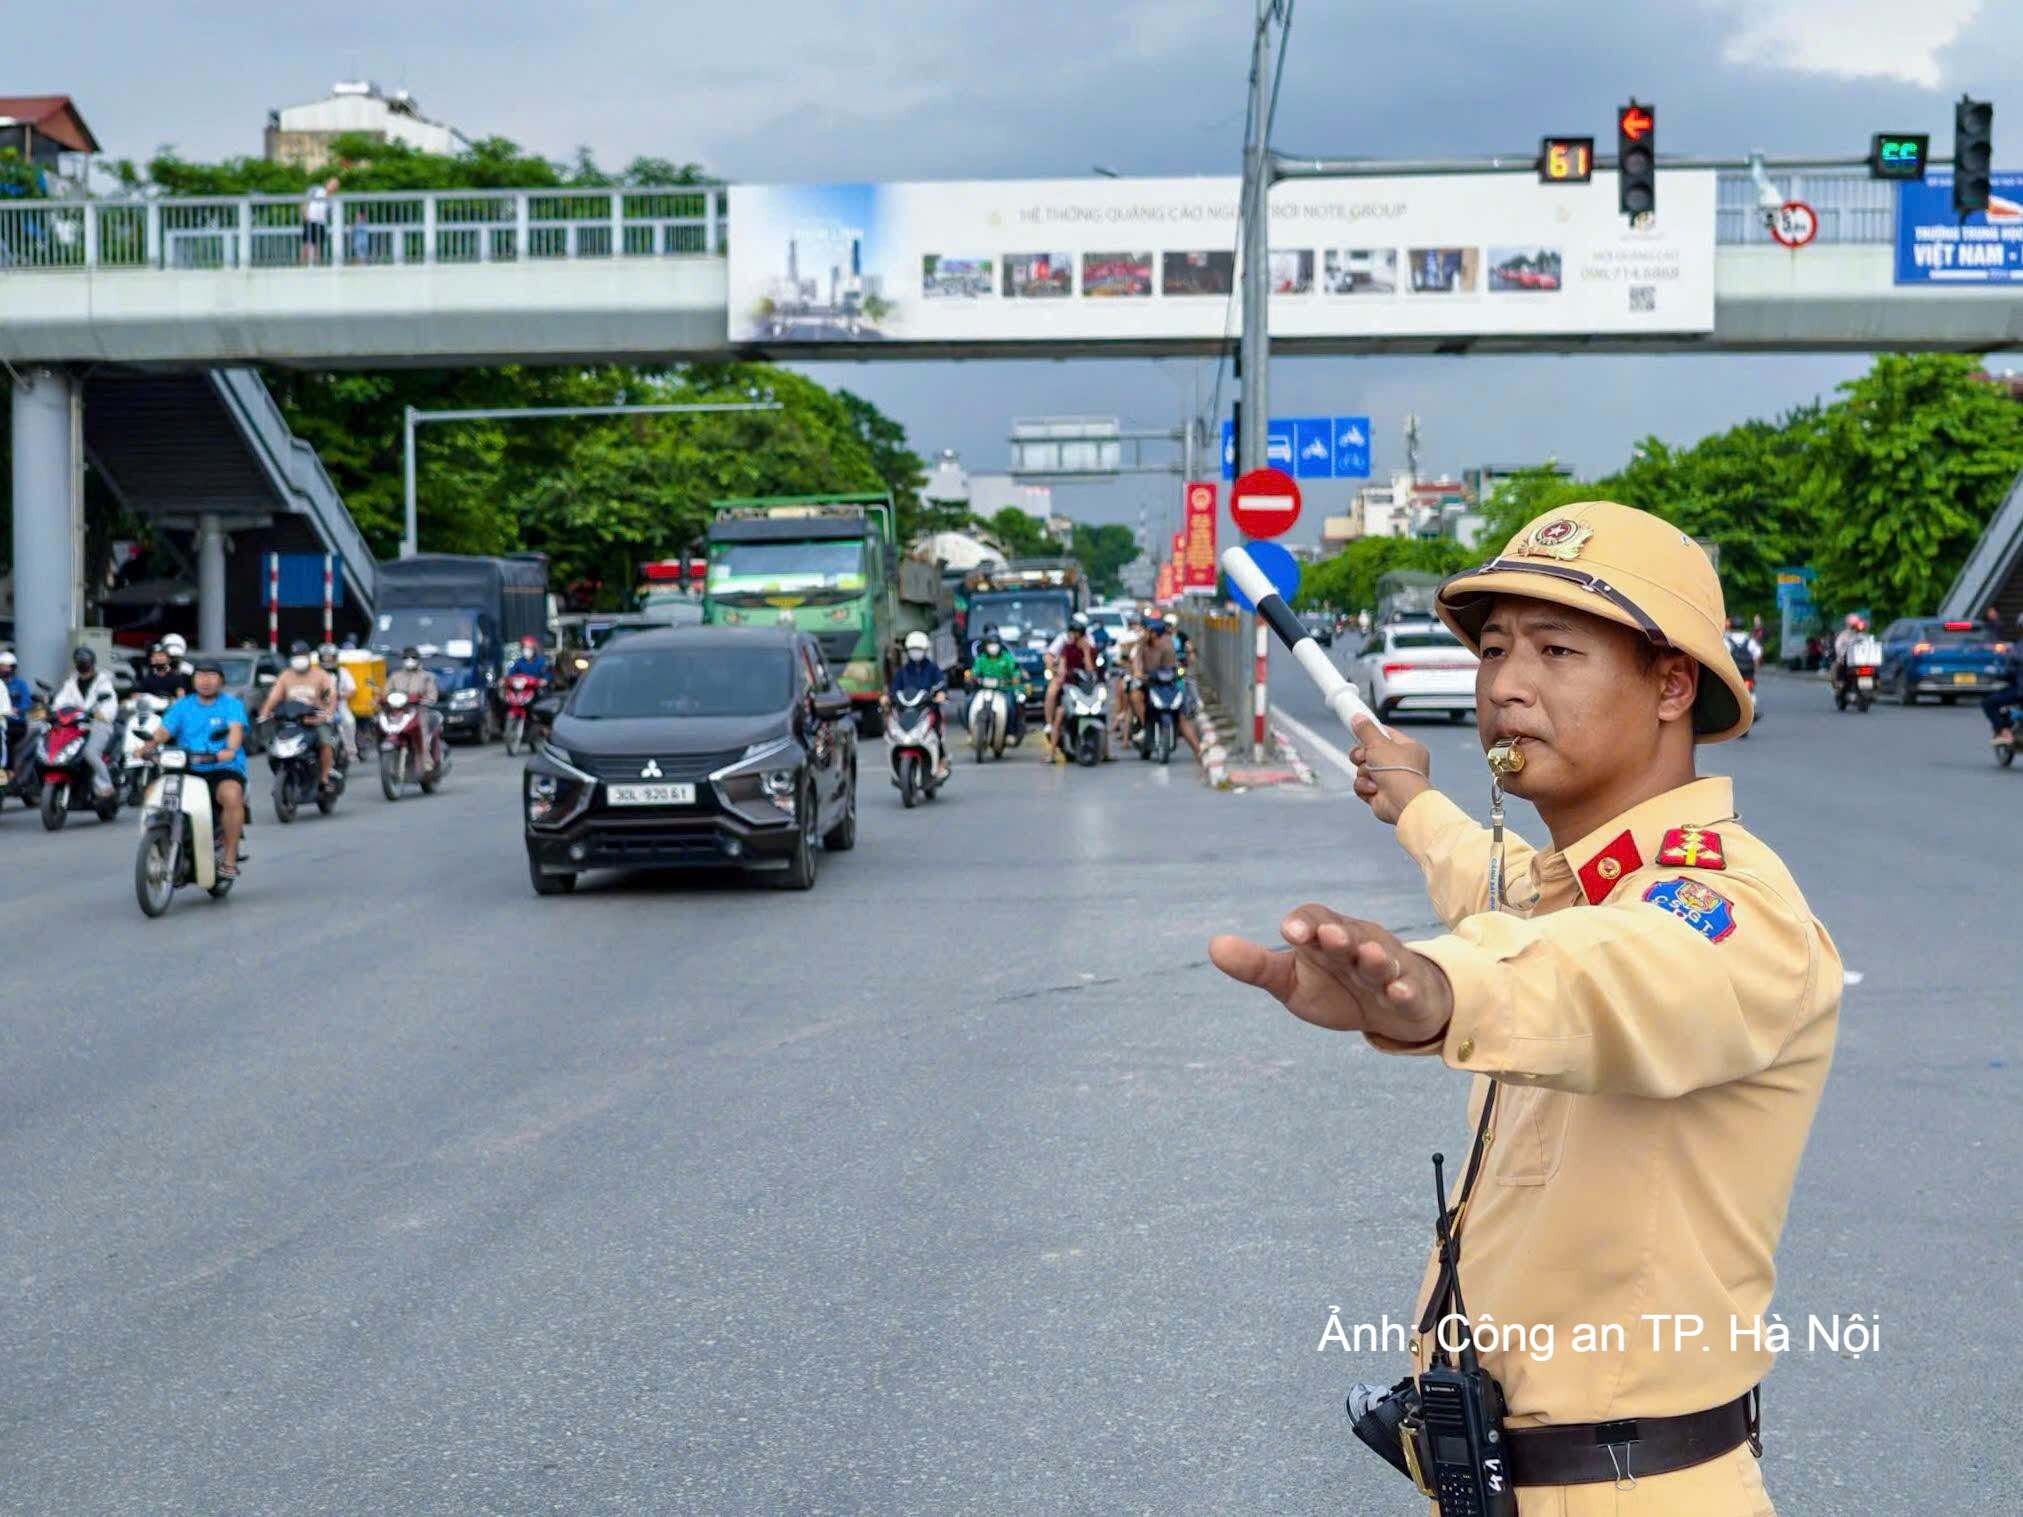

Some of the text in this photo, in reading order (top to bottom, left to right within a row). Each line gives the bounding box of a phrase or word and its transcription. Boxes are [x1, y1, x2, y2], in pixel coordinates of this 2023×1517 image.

[1550, 143, 1587, 177] 61
[1913, 240, 2004, 268] VIỆT NAM
[1654, 895, 1714, 934] CSGT
